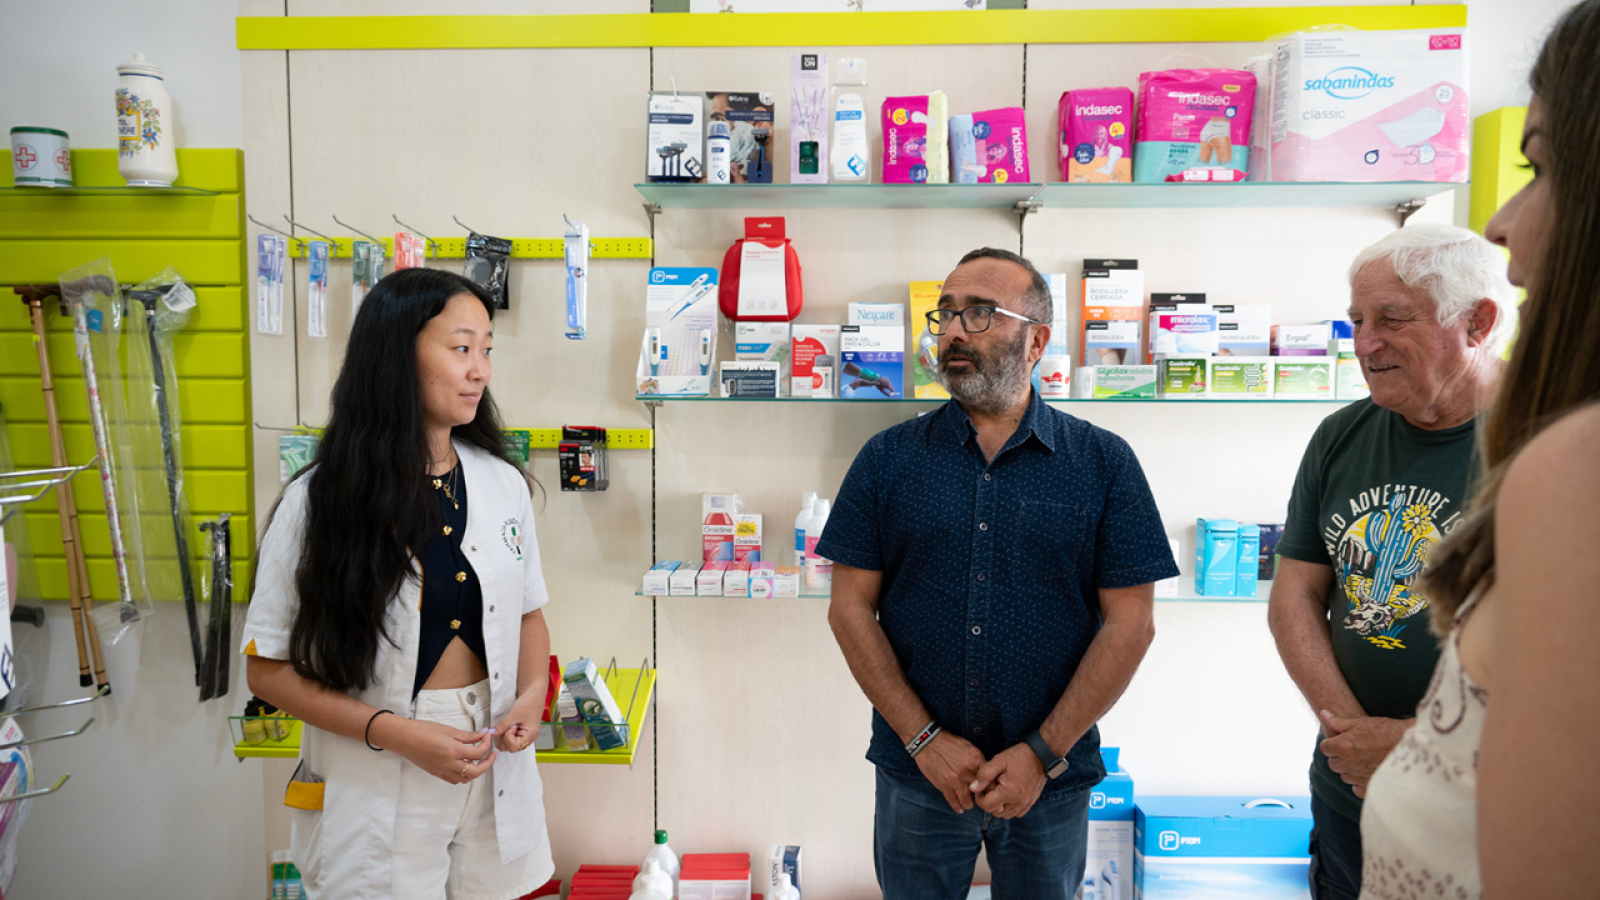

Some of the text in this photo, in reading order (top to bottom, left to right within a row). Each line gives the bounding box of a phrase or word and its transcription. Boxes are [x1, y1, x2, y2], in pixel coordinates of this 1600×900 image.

[1303, 73, 1394, 91] sabanindas
[1178, 91, 1231, 106] indasec
[1075, 104, 1122, 116] indasec
[1302, 107, 1346, 121] classic
[889, 128, 897, 165] indasec
[1011, 127, 1024, 174] indasec
[857, 309, 896, 322] Nexcare
[1170, 315, 1210, 325] microlax
[1325, 513, 1346, 556] WILD
[1181, 836, 1201, 845] PRIM
